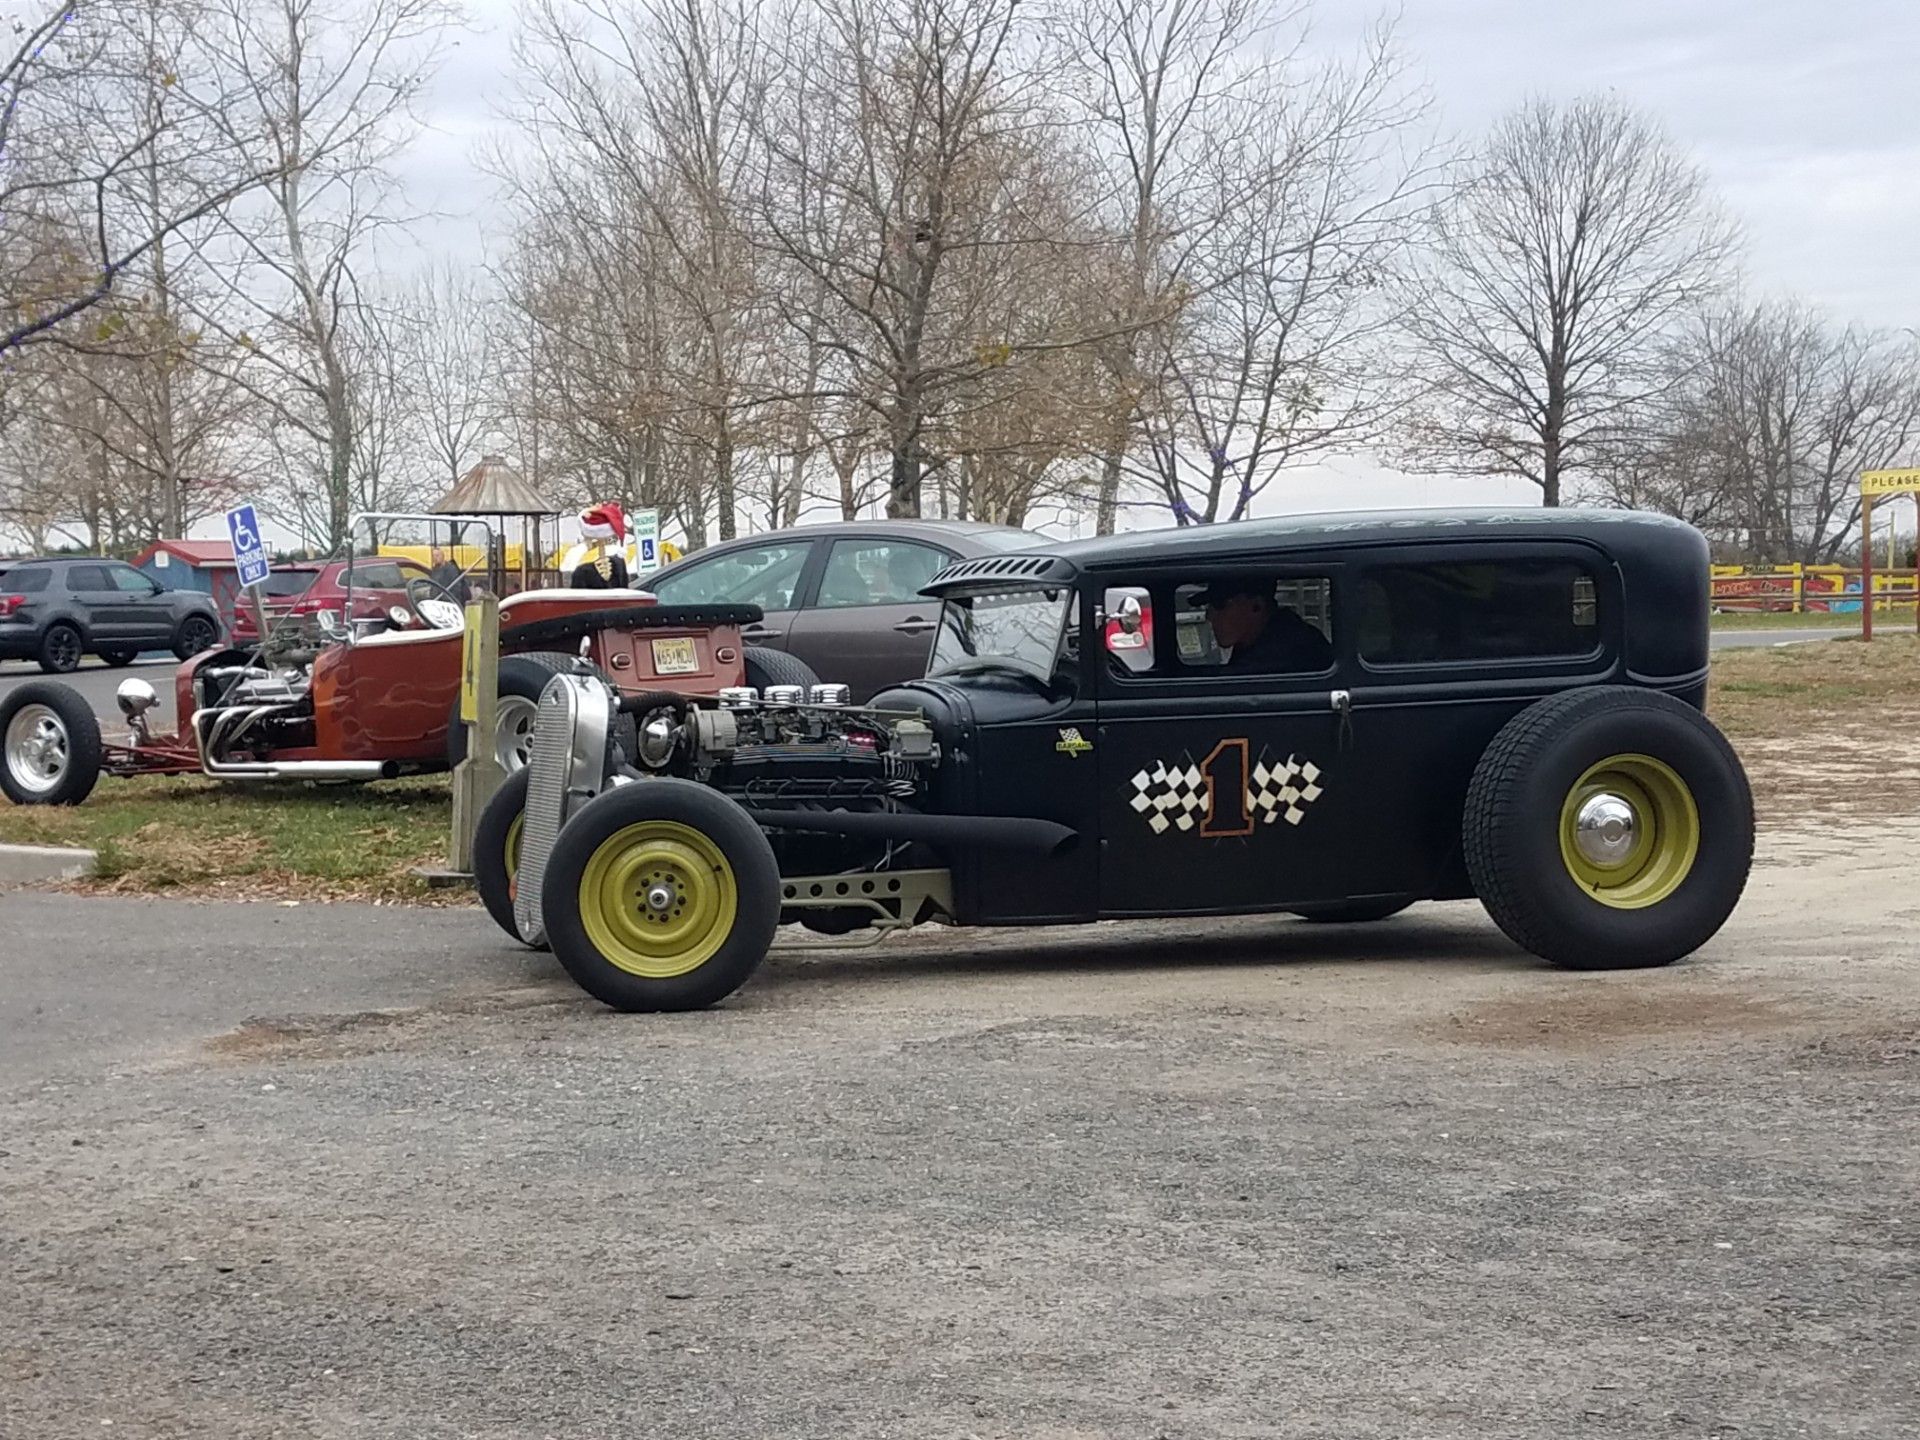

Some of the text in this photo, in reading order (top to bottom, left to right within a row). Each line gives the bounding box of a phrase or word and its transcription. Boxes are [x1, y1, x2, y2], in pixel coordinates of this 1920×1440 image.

[1871, 475, 1920, 487] PLEASE
[237, 547, 263, 567] PARKING
[244, 561, 262, 580] ONLY
[1200, 738, 1254, 837] 1
